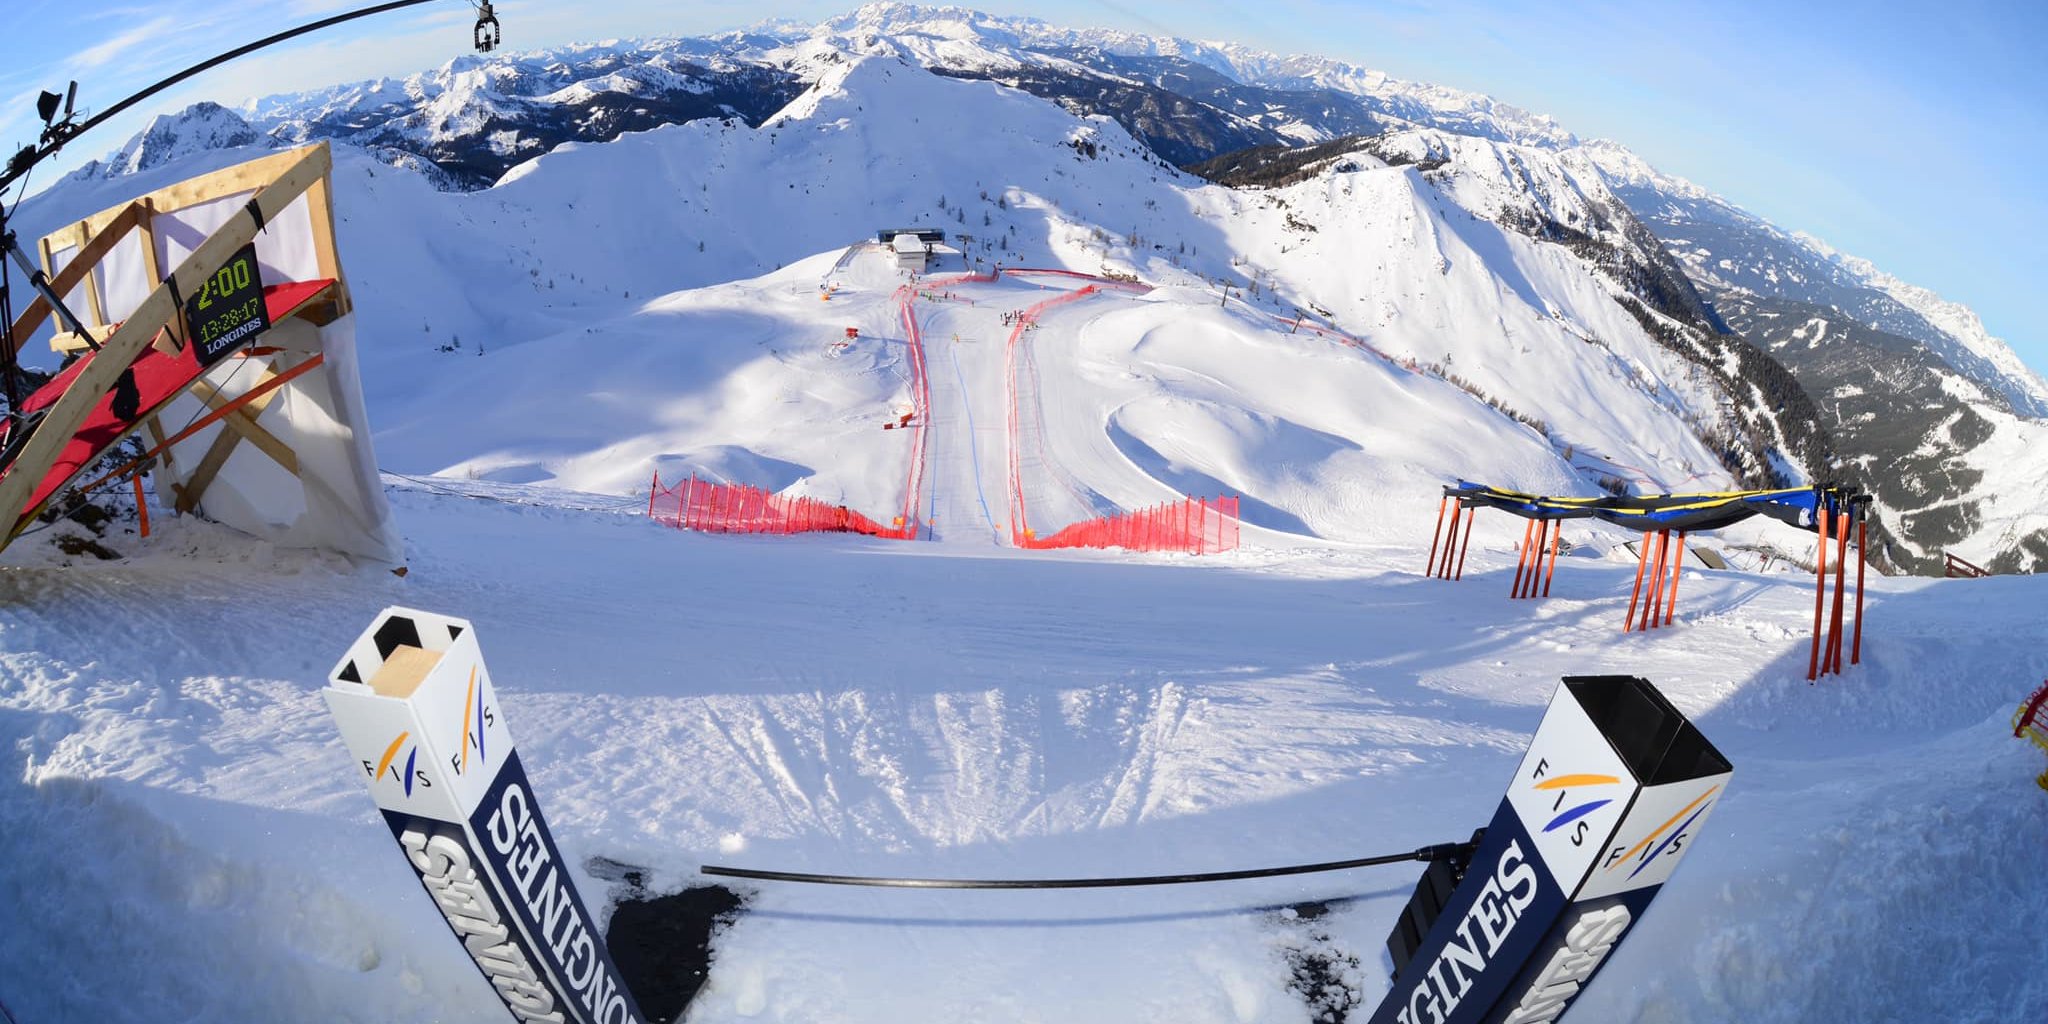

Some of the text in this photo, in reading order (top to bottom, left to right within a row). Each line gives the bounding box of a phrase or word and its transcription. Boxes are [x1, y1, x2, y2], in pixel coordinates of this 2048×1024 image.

[196, 258, 250, 311] 2:00
[200, 297, 258, 342] 13:28:17
[207, 317, 262, 355] LONGINES
[1533, 758, 1589, 847] FIS
[488, 783, 638, 1024] ONGINES
[1397, 839, 1538, 1024] GINES
